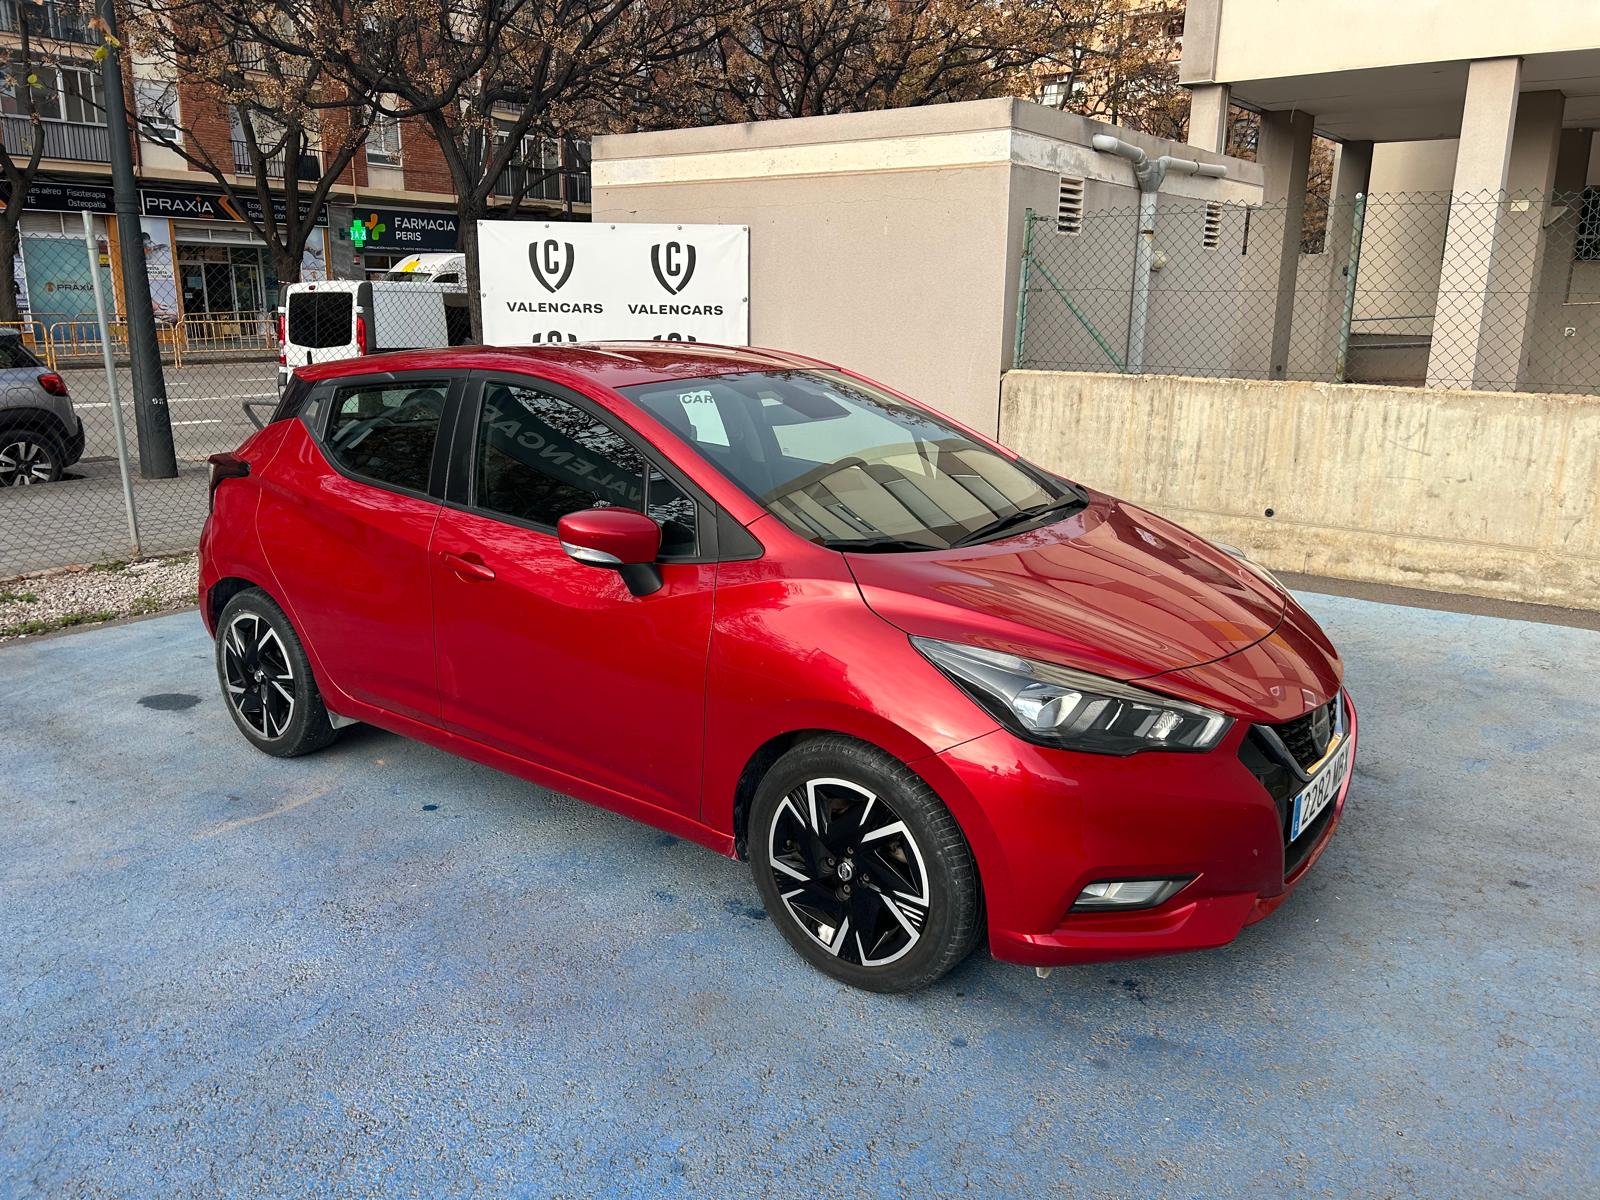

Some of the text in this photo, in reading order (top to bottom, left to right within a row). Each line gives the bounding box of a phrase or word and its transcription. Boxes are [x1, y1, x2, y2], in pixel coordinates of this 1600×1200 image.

[67, 188, 106, 199] Fisioterapia
[395, 217, 456, 231] FARMACIA
[395, 231, 422, 241] PERIS
[506, 301, 604, 314] VALENCARS
[627, 303, 724, 316] VALENCARS
[1302, 769, 1332, 826] 2282
